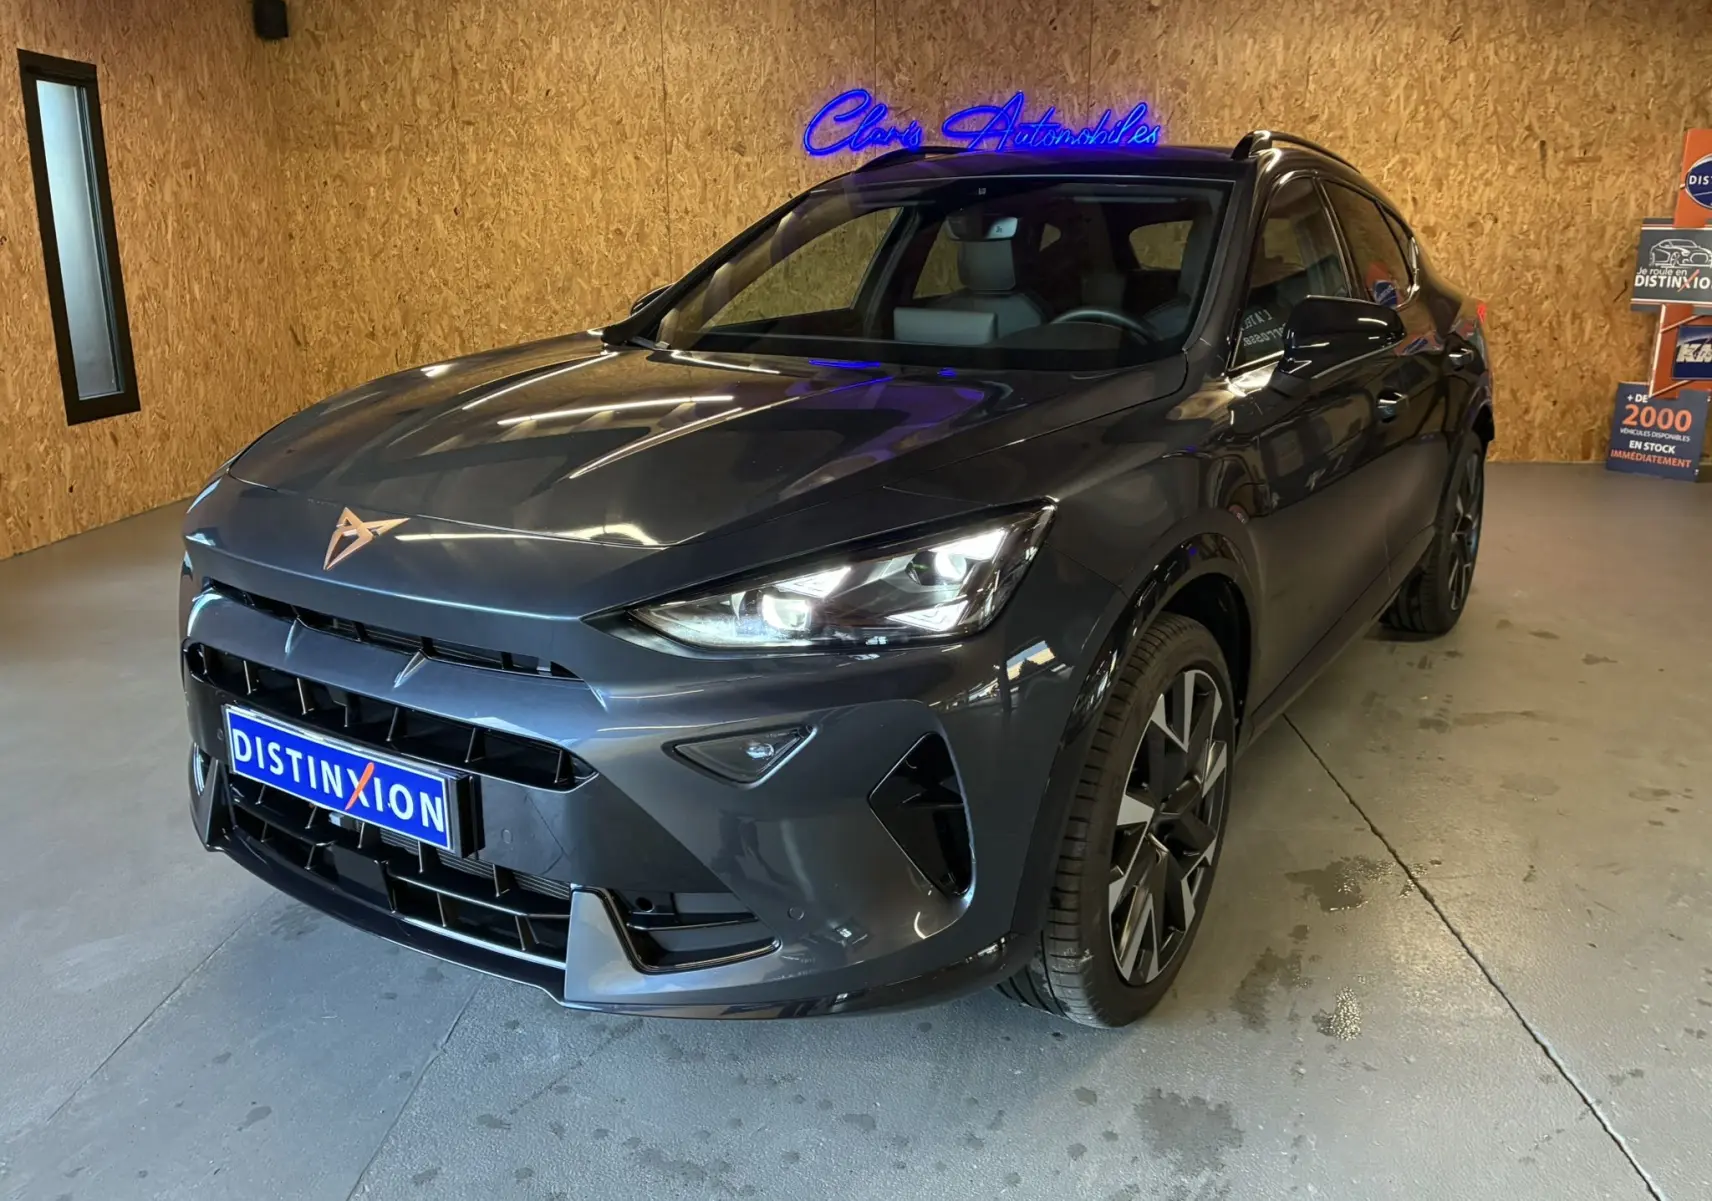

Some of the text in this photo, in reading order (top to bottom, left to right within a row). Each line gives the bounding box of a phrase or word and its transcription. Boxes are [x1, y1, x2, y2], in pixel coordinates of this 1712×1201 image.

[942, 90, 1161, 152] Automobiles
[1689, 174, 1712, 185] DIS
[1636, 266, 1648, 275] Je
[1634, 270, 1712, 291] DISTINXIO
[1635, 393, 1648, 403] DE
[1622, 403, 1692, 432] 2000
[1651, 431, 1691, 442] DISPONIBLES
[1629, 440, 1676, 454] EN STOCK
[232, 727, 444, 833] DISTINXION
